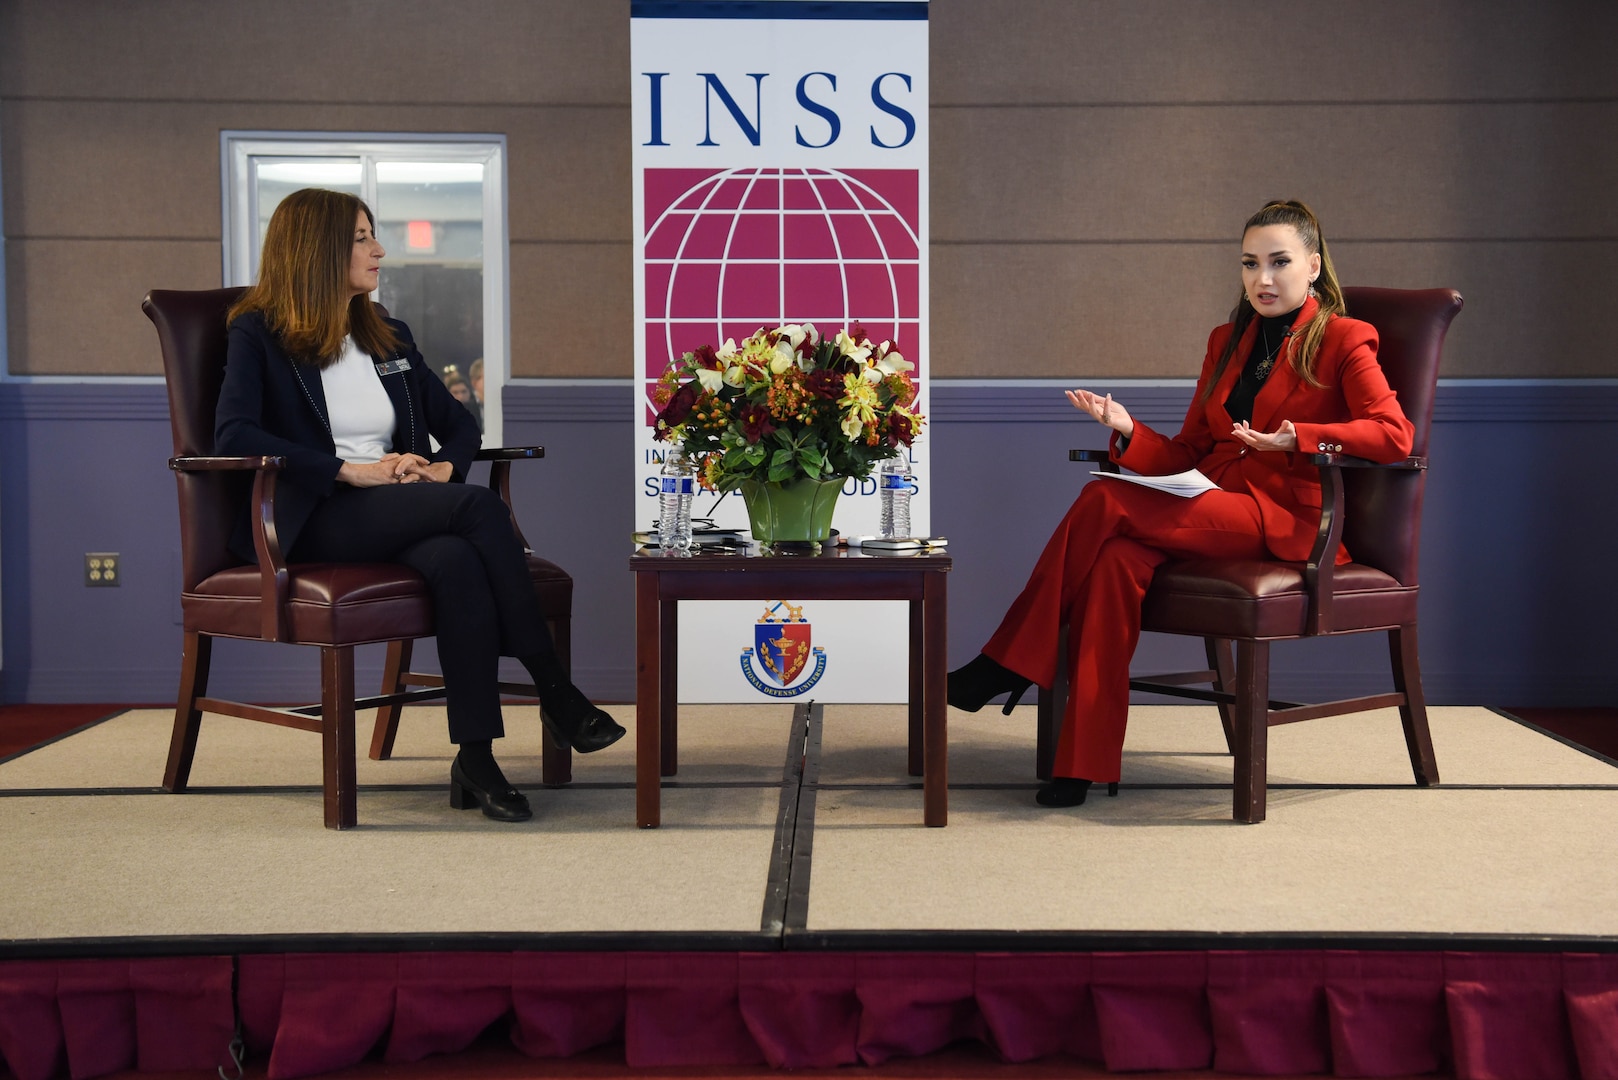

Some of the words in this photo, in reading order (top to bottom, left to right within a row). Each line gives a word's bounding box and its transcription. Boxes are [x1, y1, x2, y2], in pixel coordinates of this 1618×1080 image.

[641, 71, 917, 149] INSS
[743, 658, 763, 690] NATIONAL
[763, 687, 797, 696] DEFENSE
[799, 656, 825, 691] UNIVERSITY
